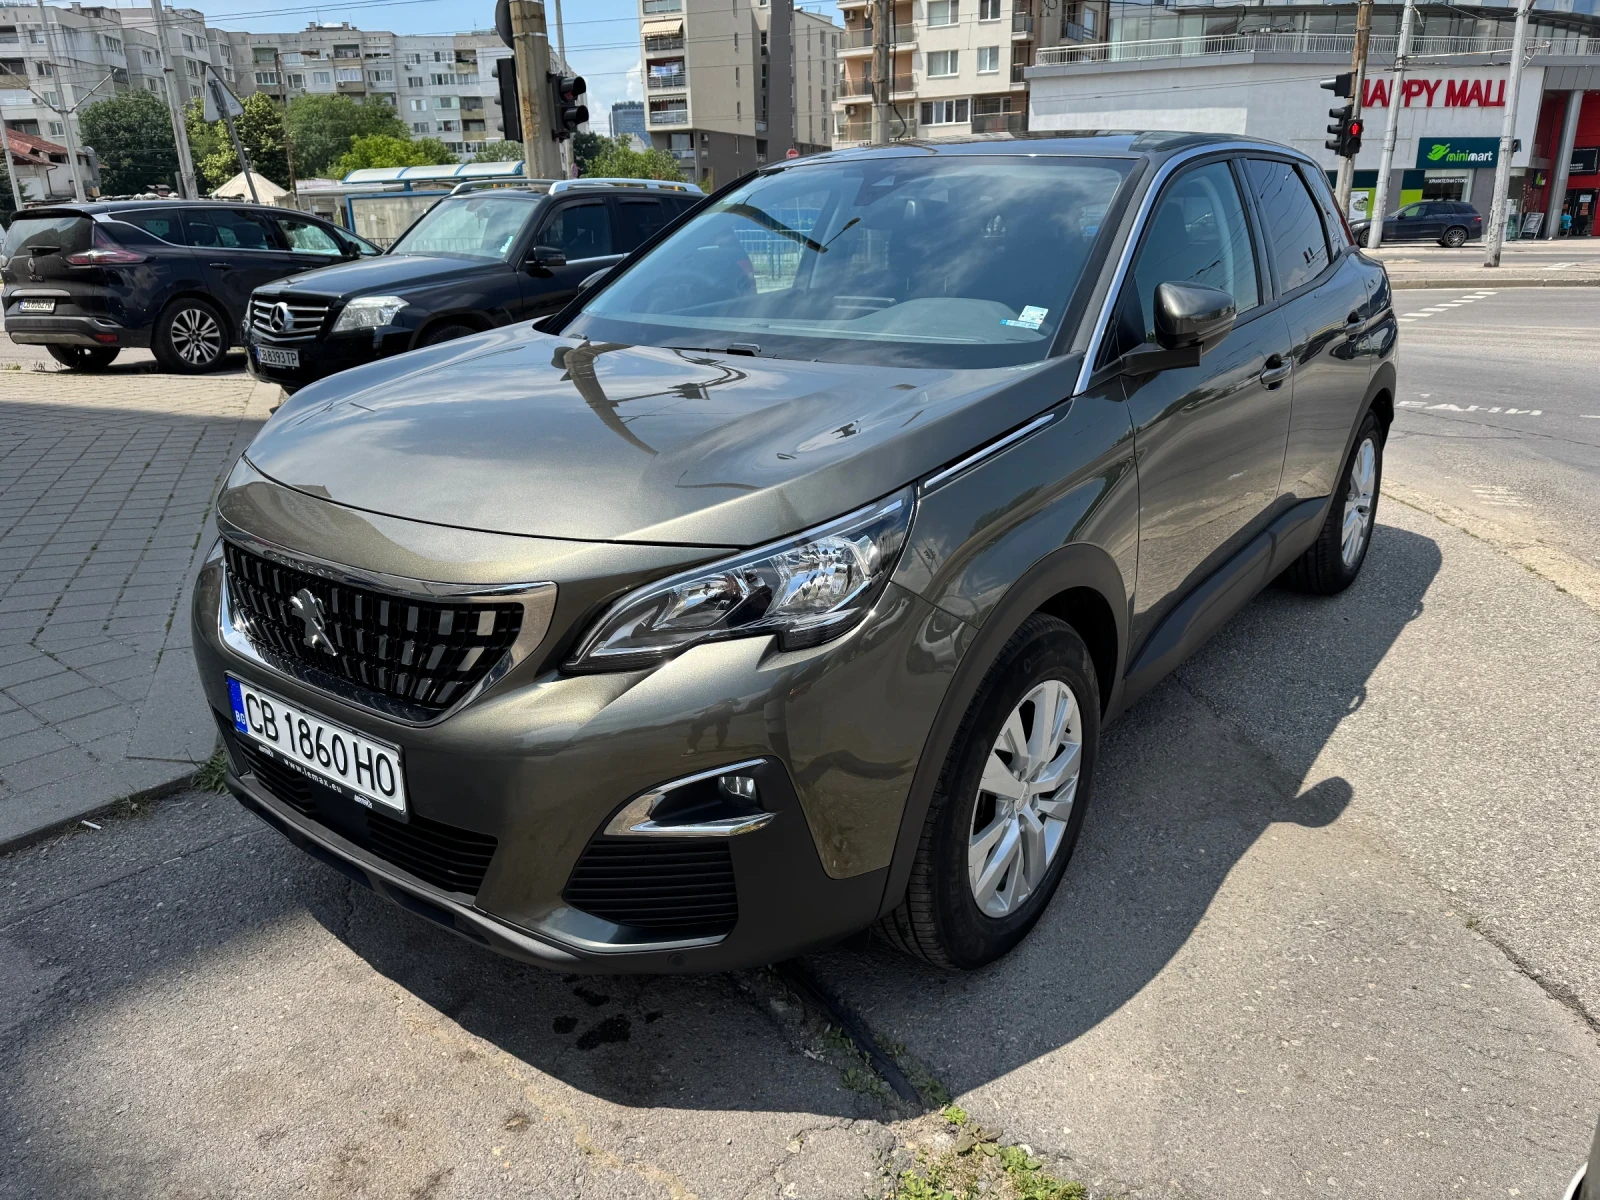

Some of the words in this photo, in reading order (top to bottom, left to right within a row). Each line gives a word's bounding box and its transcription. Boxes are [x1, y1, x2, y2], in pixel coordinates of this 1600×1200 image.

[1445, 79, 1506, 107] MALL
[1446, 149, 1493, 162] minimart
[235, 709, 247, 725] BG
[245, 692, 279, 742] CB
[284, 711, 349, 777] 1860
[352, 739, 396, 797] HO
[283, 758, 342, 794] www.lemax.eu
